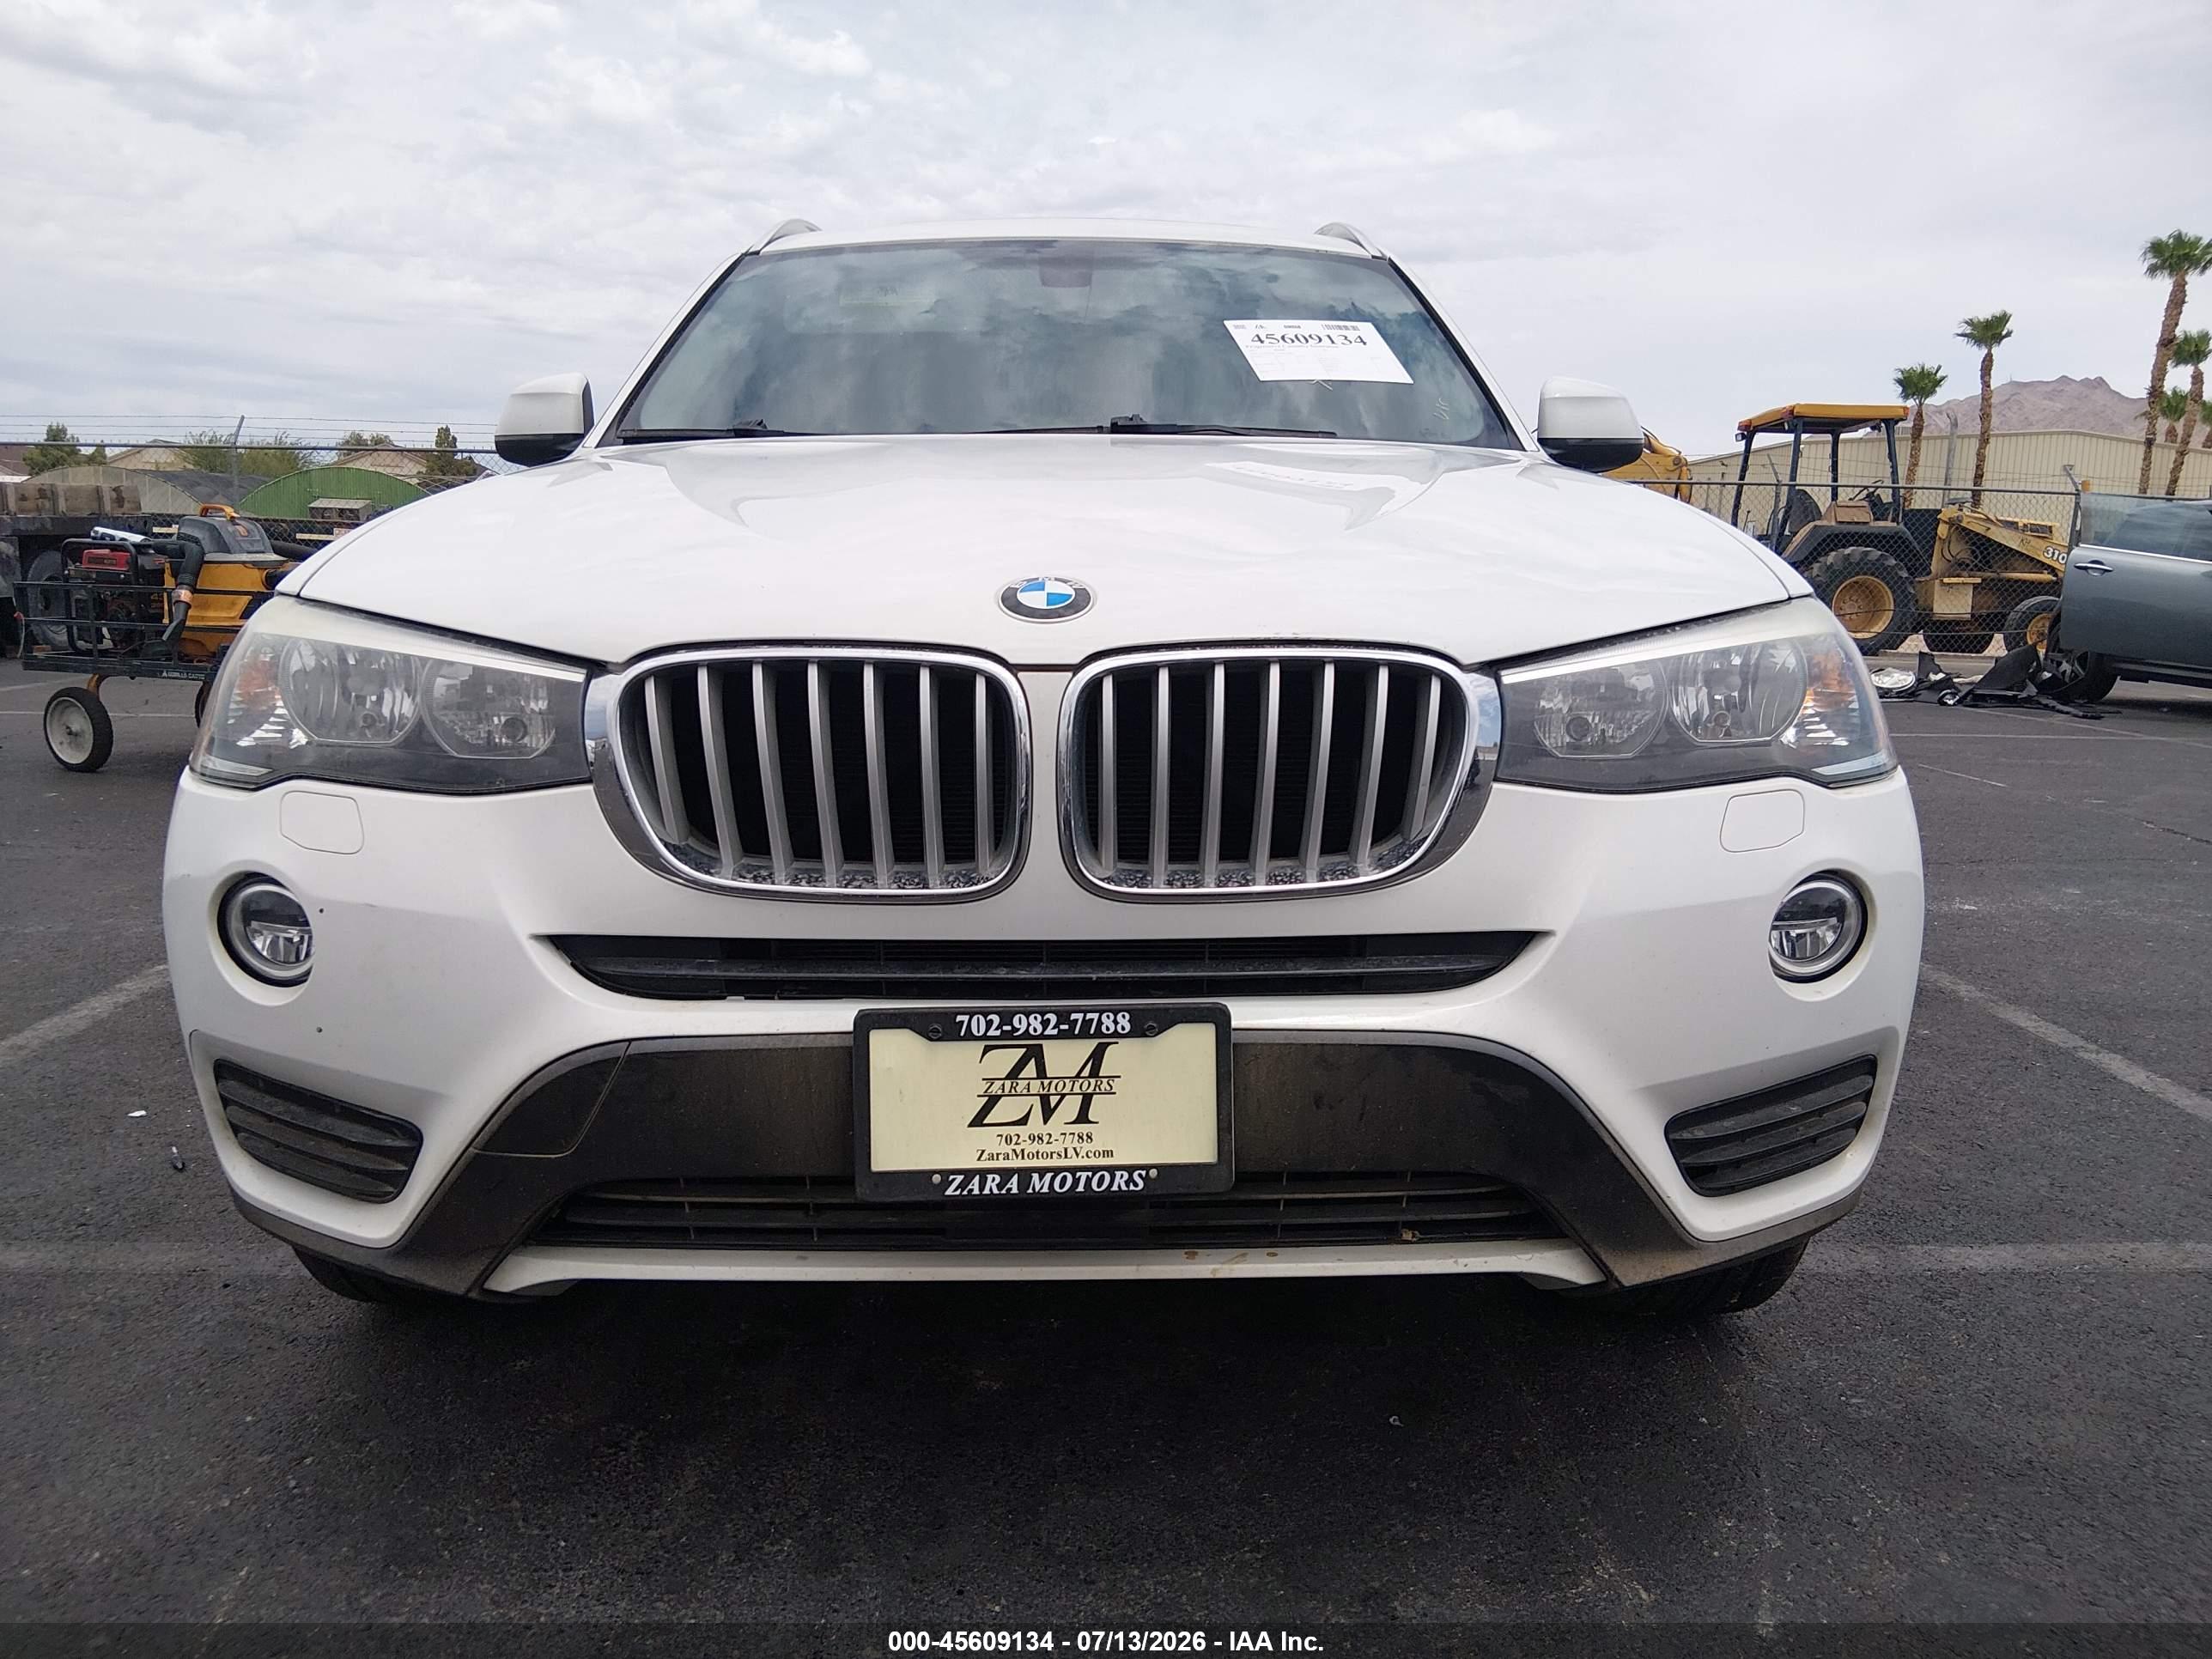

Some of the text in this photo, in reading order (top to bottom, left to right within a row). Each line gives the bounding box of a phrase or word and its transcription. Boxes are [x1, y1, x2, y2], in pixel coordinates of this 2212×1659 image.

[1250, 332, 1368, 346] 45609134
[2043, 546, 2068, 564] 310
[956, 1012, 1131, 1036] 702-982-7788
[982, 1079, 1115, 1094] ZARA MOTORS
[996, 1132, 1094, 1146] 702-982-7788
[976, 1146, 1115, 1162] ZaraMotorsLV.com
[944, 1169, 1146, 1196] ZARA MOTORS
